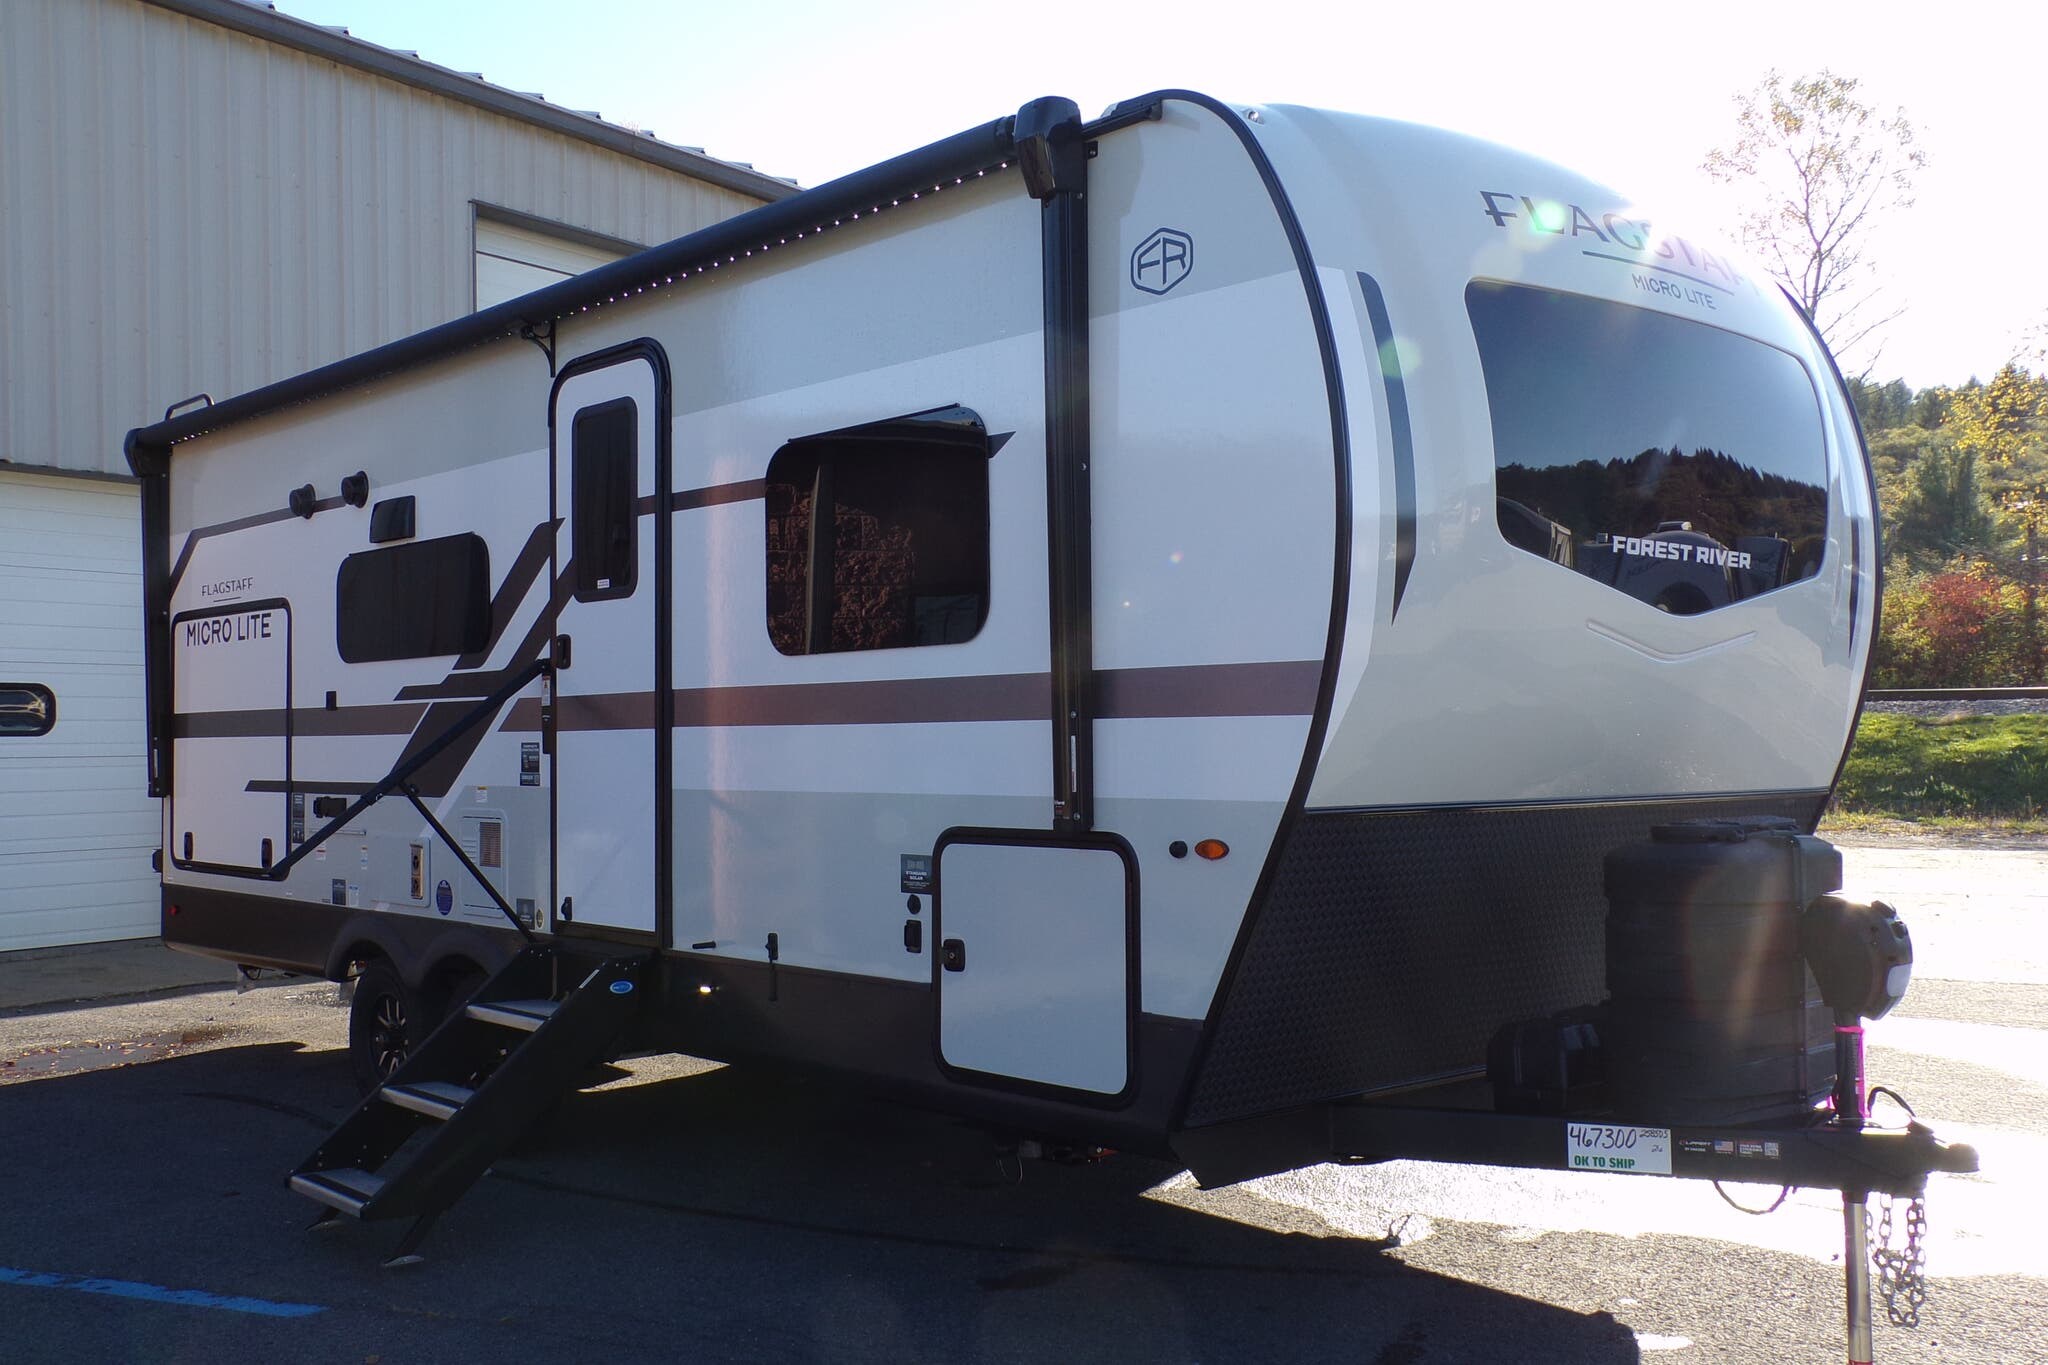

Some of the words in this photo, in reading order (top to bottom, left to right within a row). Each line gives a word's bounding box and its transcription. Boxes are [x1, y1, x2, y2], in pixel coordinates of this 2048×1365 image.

[1632, 273, 1682, 299] MICRO
[1685, 287, 1717, 310] LITE
[1612, 535, 1693, 562] FOREST
[1696, 546, 1751, 570] RIVER
[201, 577, 254, 597] FLAGSTAFF
[186, 617, 232, 647] MICRO
[237, 612, 272, 641] LITE
[1569, 1126, 1637, 1149] 467300
[1574, 1155, 1589, 1167] OK
[1592, 1156, 1606, 1168] TO
[1609, 1157, 1635, 1169] SHIP
